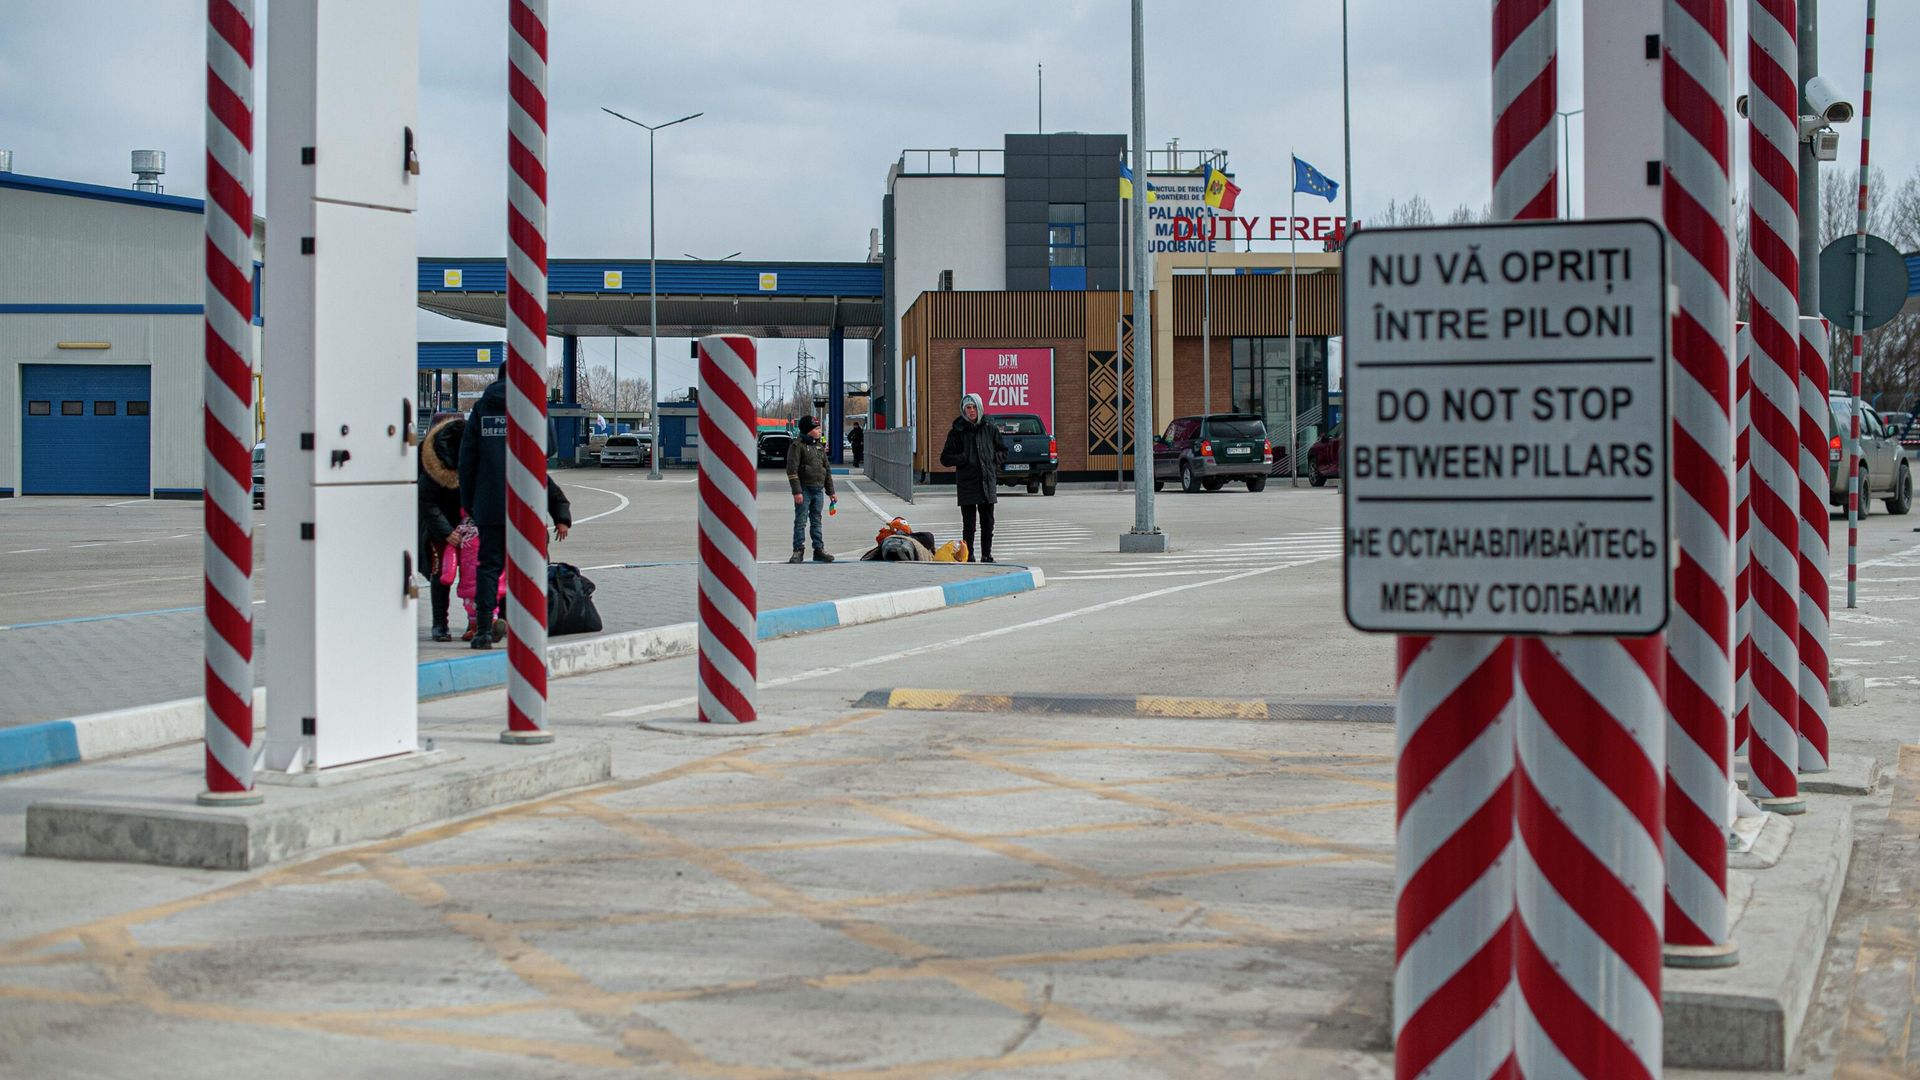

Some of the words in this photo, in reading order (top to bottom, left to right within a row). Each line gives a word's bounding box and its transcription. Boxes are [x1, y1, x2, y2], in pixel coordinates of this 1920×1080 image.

[1148, 240, 1217, 253] UDOBNOE
[1173, 217, 1259, 241] DUTY
[1369, 254, 1421, 286] NU
[1434, 244, 1488, 285] VĂ
[1501, 248, 1632, 295] OPRIȚI
[1373, 303, 1489, 341] ÎNTRE
[1502, 305, 1633, 339] PILONI
[998, 354, 1018, 366] DFM
[988, 373, 1029, 386] PARKING
[988, 386, 1029, 406] ZONE
[1377, 389, 1430, 422] DO
[1442, 388, 1519, 422] NOT
[1531, 386, 1634, 421] STOP
[1354, 444, 1503, 479] BETWEEN
[1511, 443, 1654, 478] PILLARS
[1348, 528, 1381, 557] НЕ
[1387, 521, 1657, 559] ОСТАНАВЛИВАЙТЕСЬ
[1380, 582, 1480, 618] МЕЖДУ
[1487, 583, 1642, 615] СТОЛБАМИ
